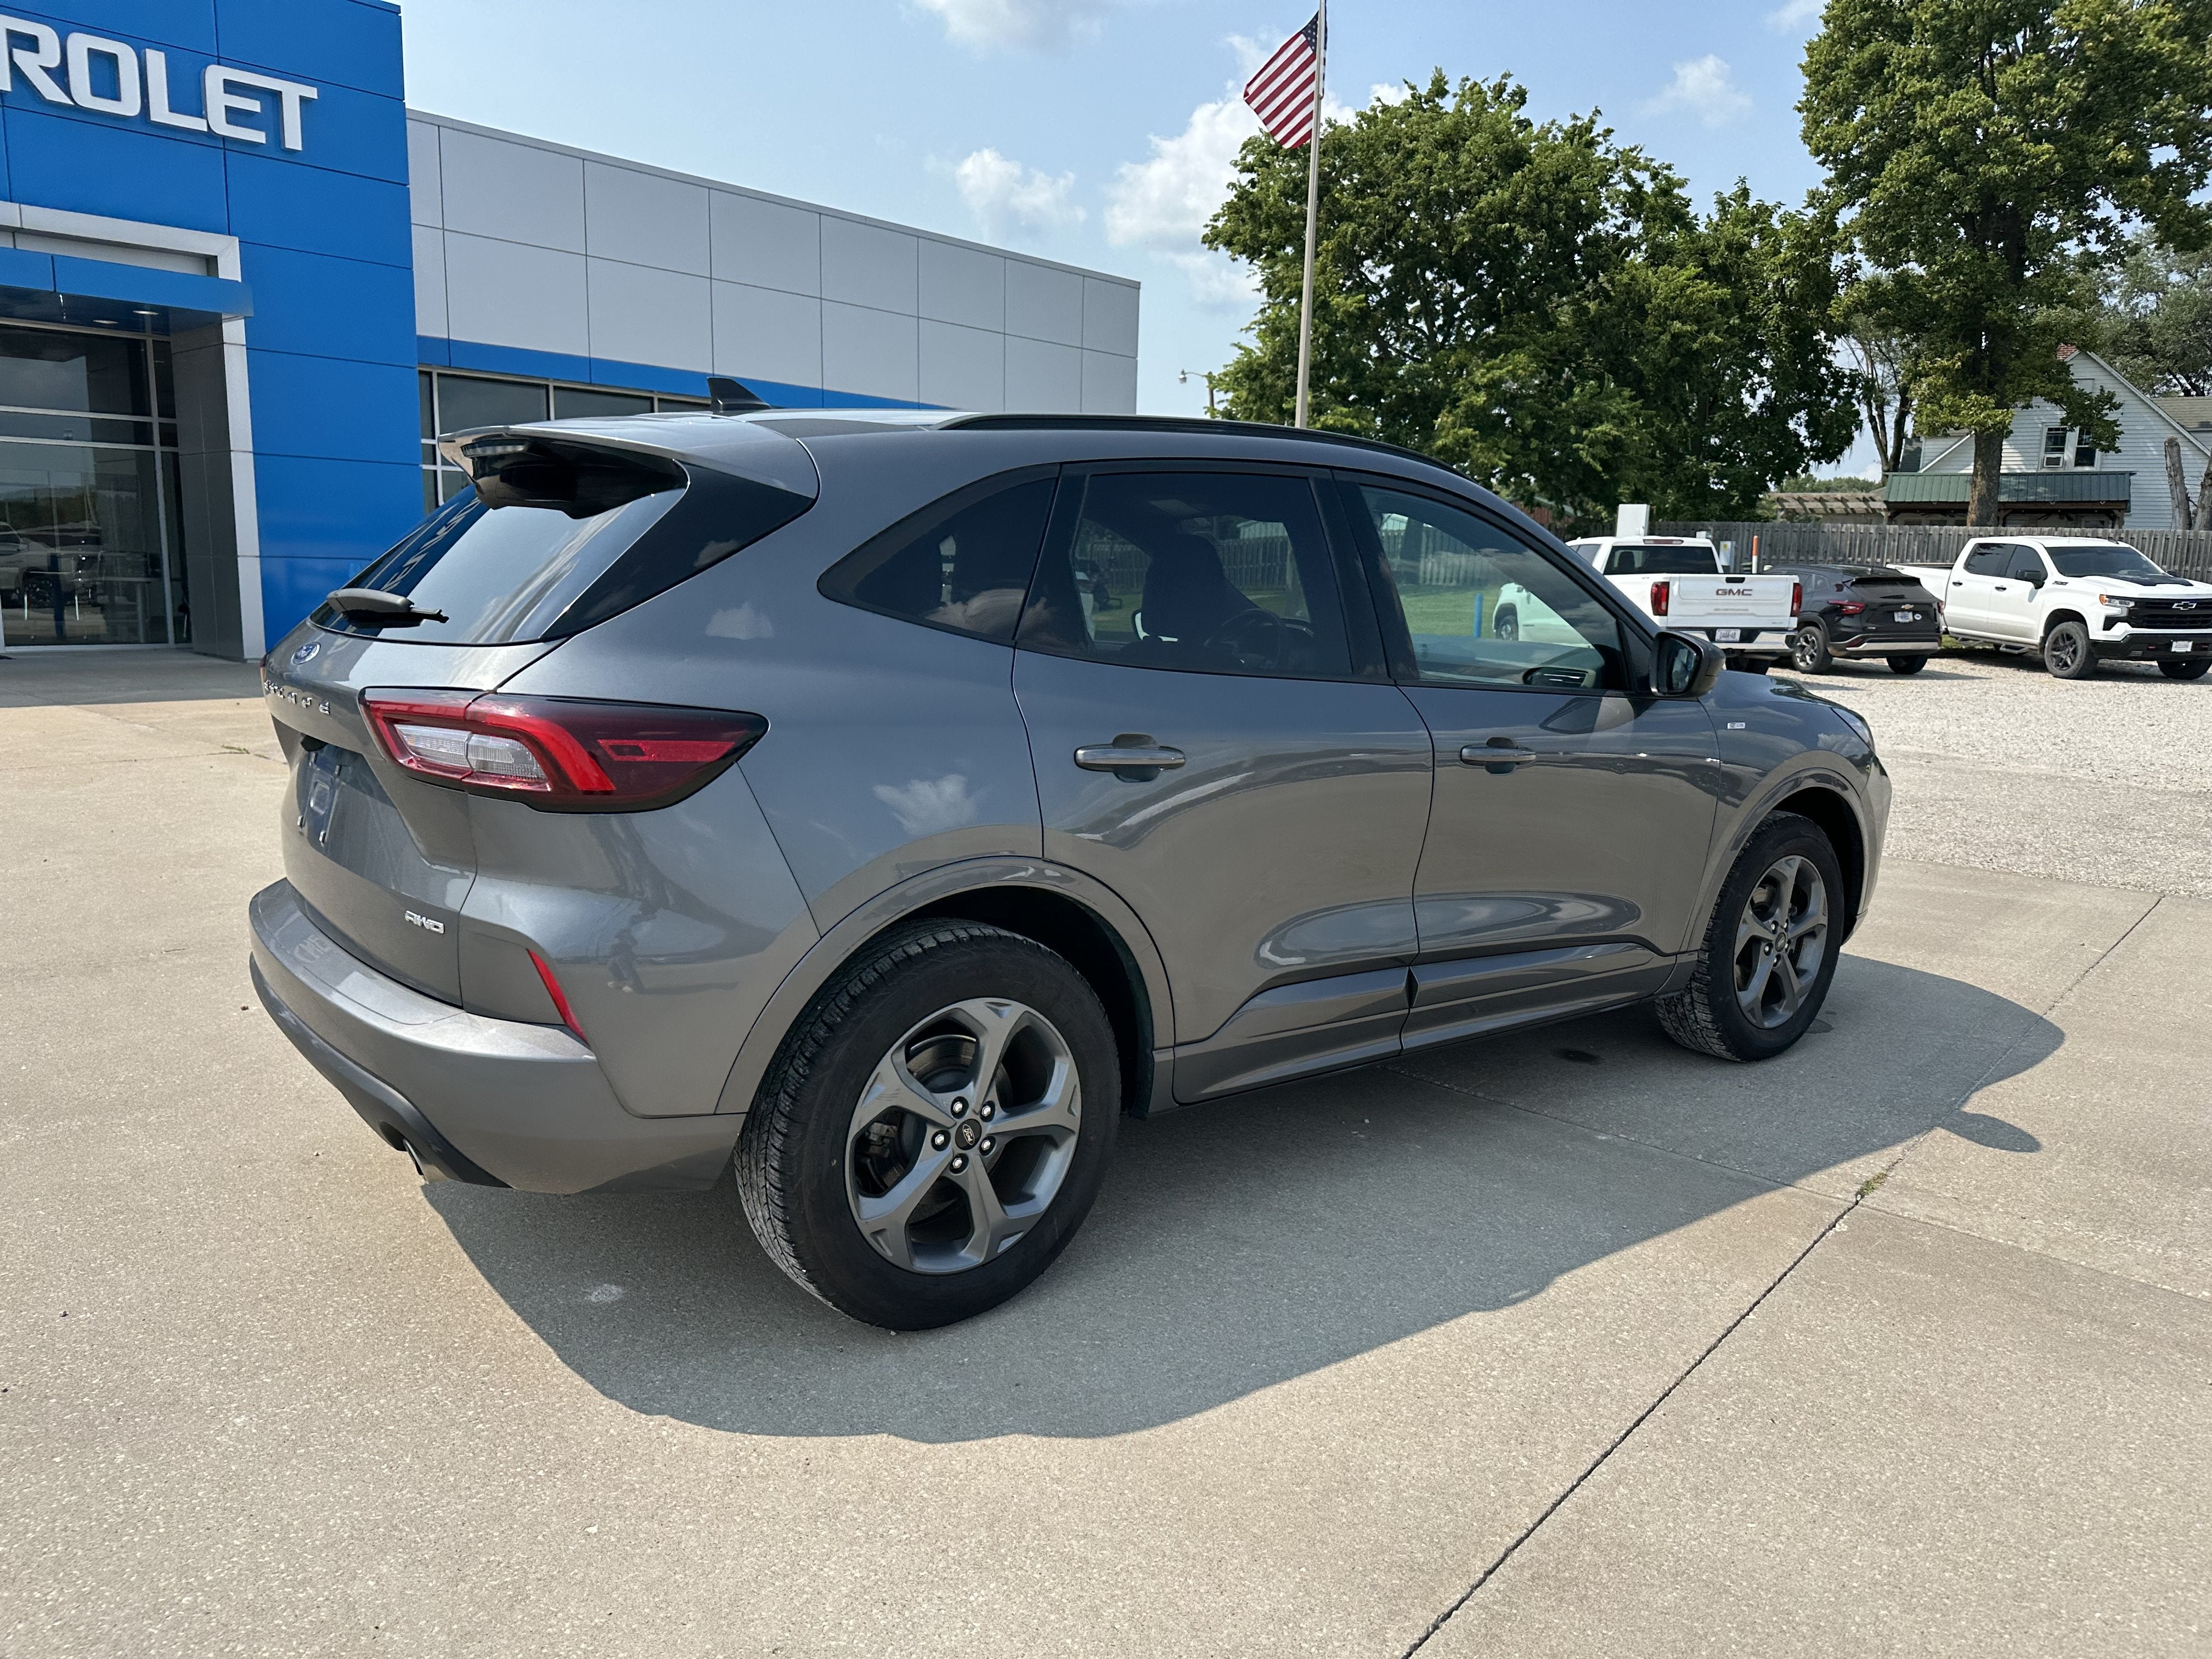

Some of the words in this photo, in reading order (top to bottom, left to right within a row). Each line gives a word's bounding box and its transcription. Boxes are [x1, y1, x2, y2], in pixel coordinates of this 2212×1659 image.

[0, 14, 318, 151] ROLET
[405, 911, 445, 934] AWD
[963, 1127, 974, 1143] Ford
